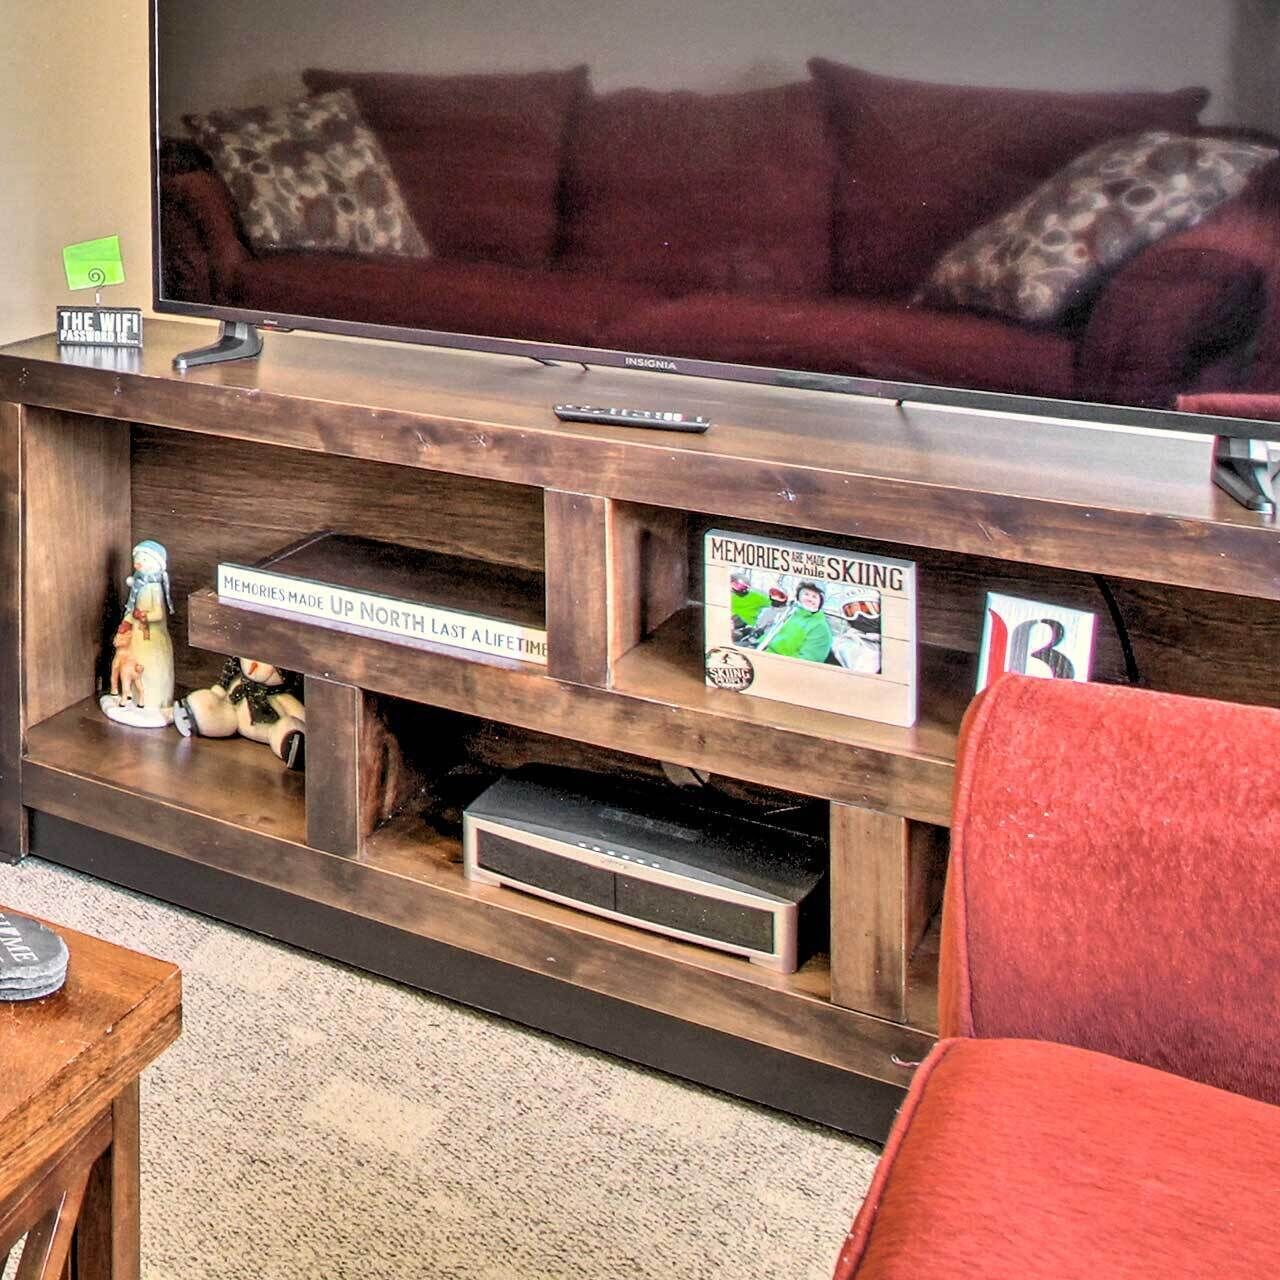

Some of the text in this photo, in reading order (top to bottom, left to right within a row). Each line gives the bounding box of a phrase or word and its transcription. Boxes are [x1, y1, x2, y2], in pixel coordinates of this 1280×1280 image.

[60, 311, 139, 334] THE WIFI
[60, 329, 115, 342] PASSWORD
[625, 357, 677, 370] INSIGNIA
[711, 537, 790, 572] MEMORIES
[791, 550, 826, 567] ARE MADE
[792, 564, 825, 578] while
[827, 557, 903, 591] SKIING
[224, 575, 285, 601] MEMORIES
[288, 591, 324, 610] MADE
[330, 595, 354, 616] UP
[360, 602, 425, 633] NORTH
[432, 618, 466, 639] LAST
[472, 629, 481, 642] A
